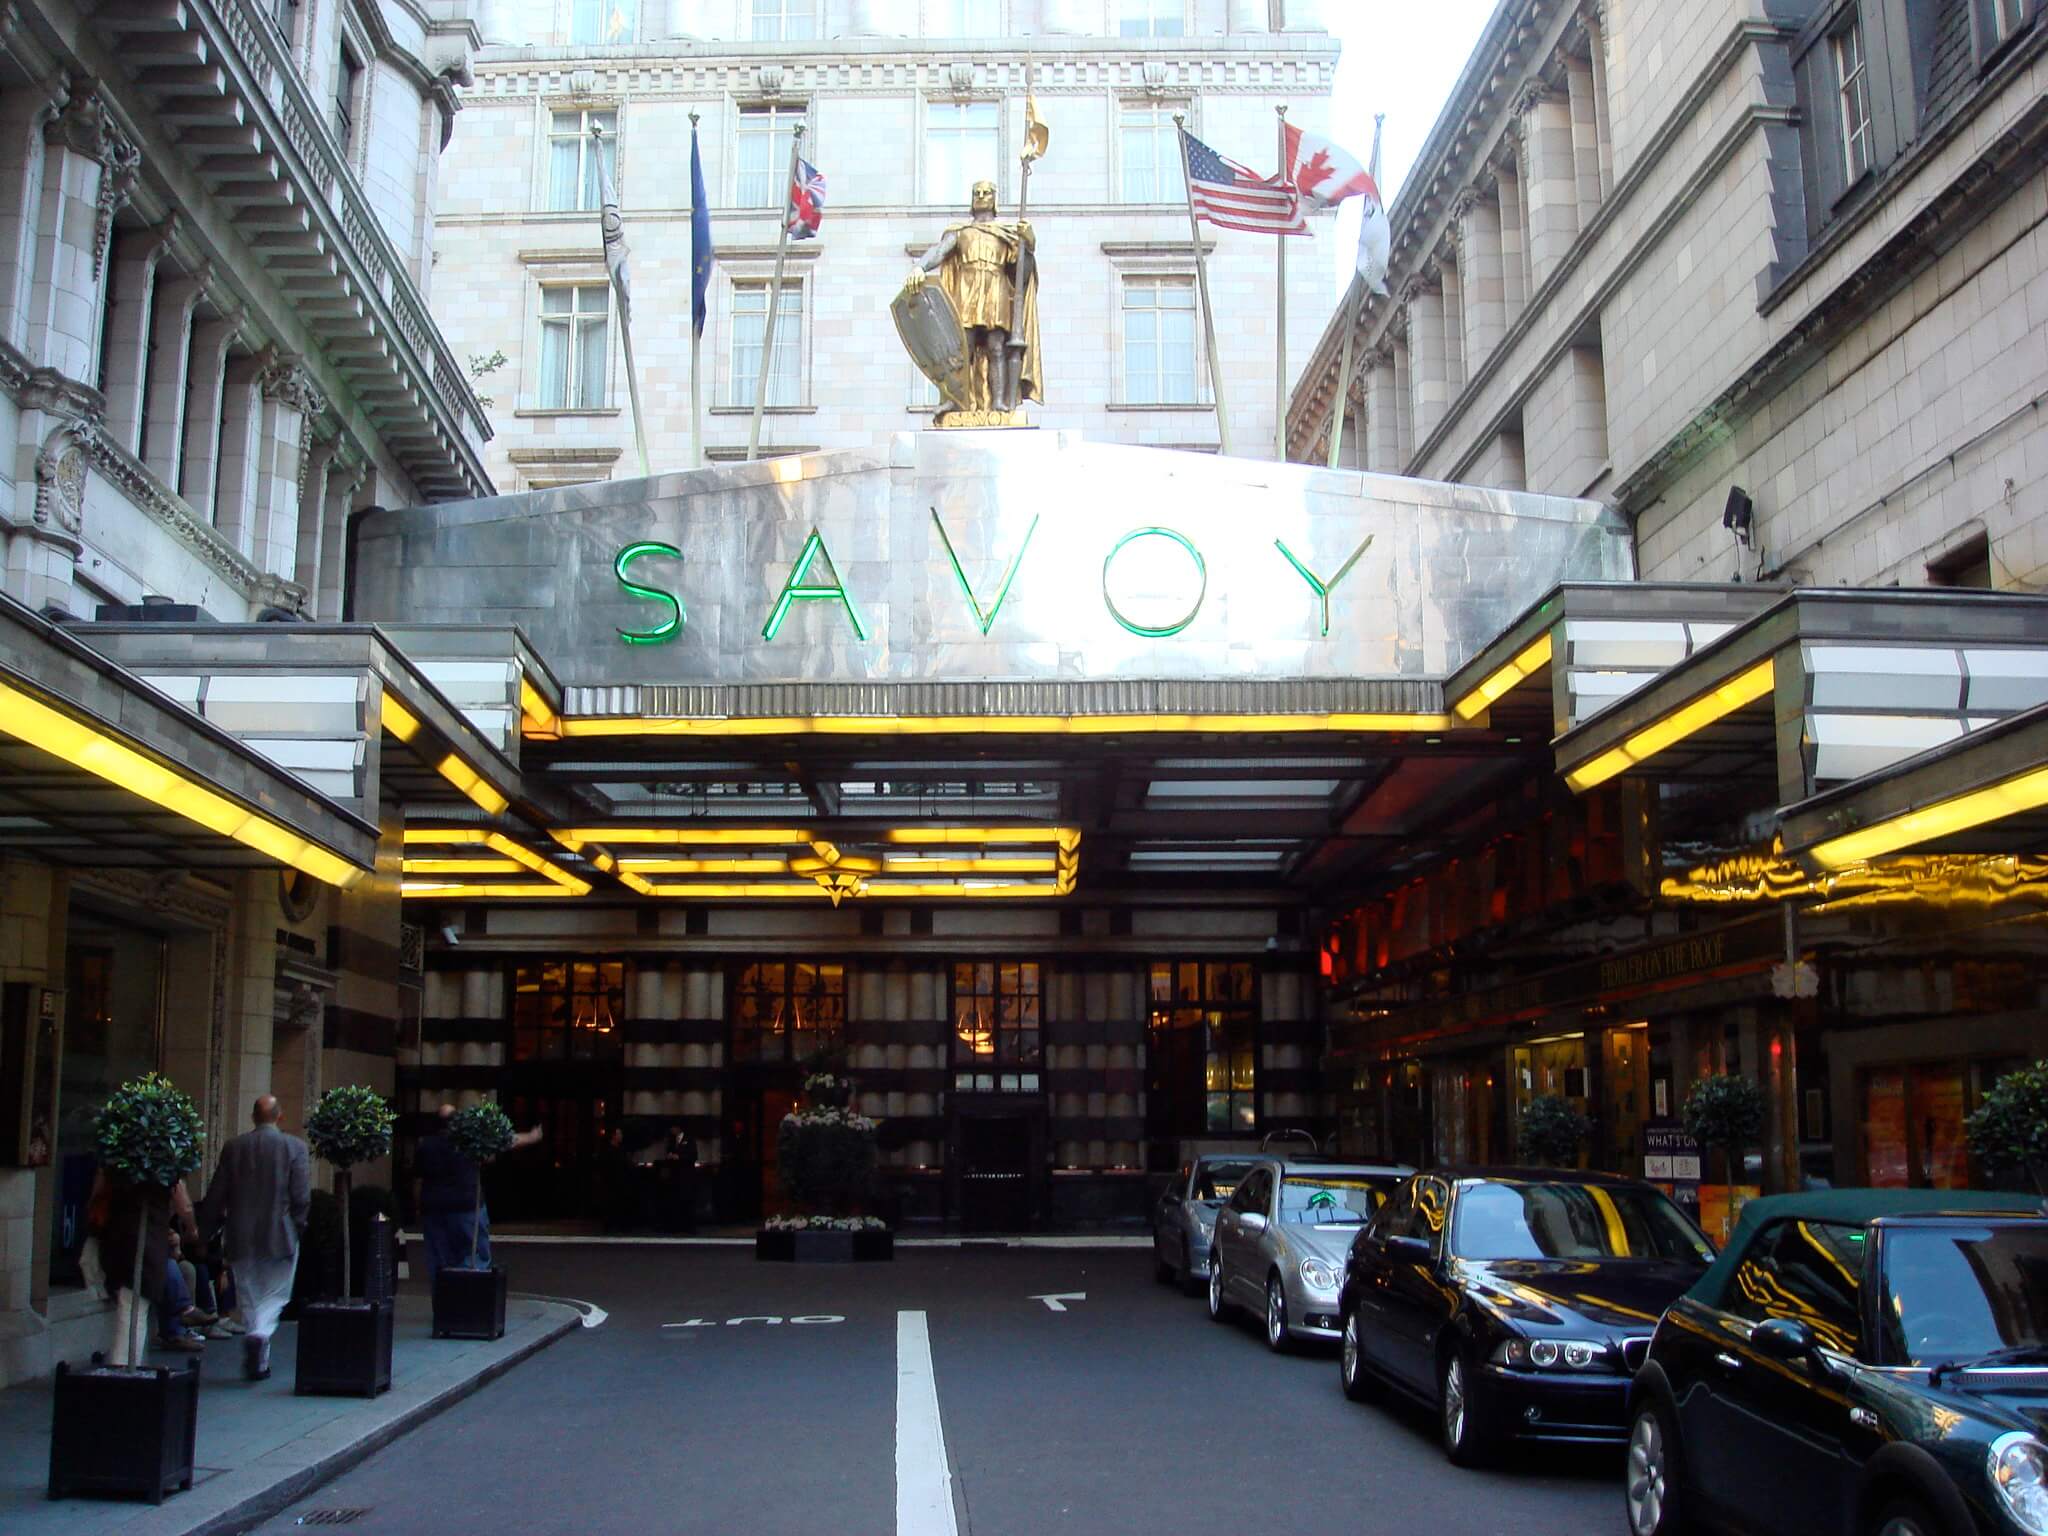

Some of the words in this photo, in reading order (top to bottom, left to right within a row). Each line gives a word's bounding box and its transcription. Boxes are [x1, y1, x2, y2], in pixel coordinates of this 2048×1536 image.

[950, 411, 1016, 426] SAVOY
[614, 506, 1374, 645] SAVOY
[1645, 950, 1662, 977] ON
[1663, 943, 1689, 975] THE
[1689, 933, 1726, 969] ROOF
[1683, 1135, 1698, 1147] ON
[661, 1315, 846, 1327] OUT
